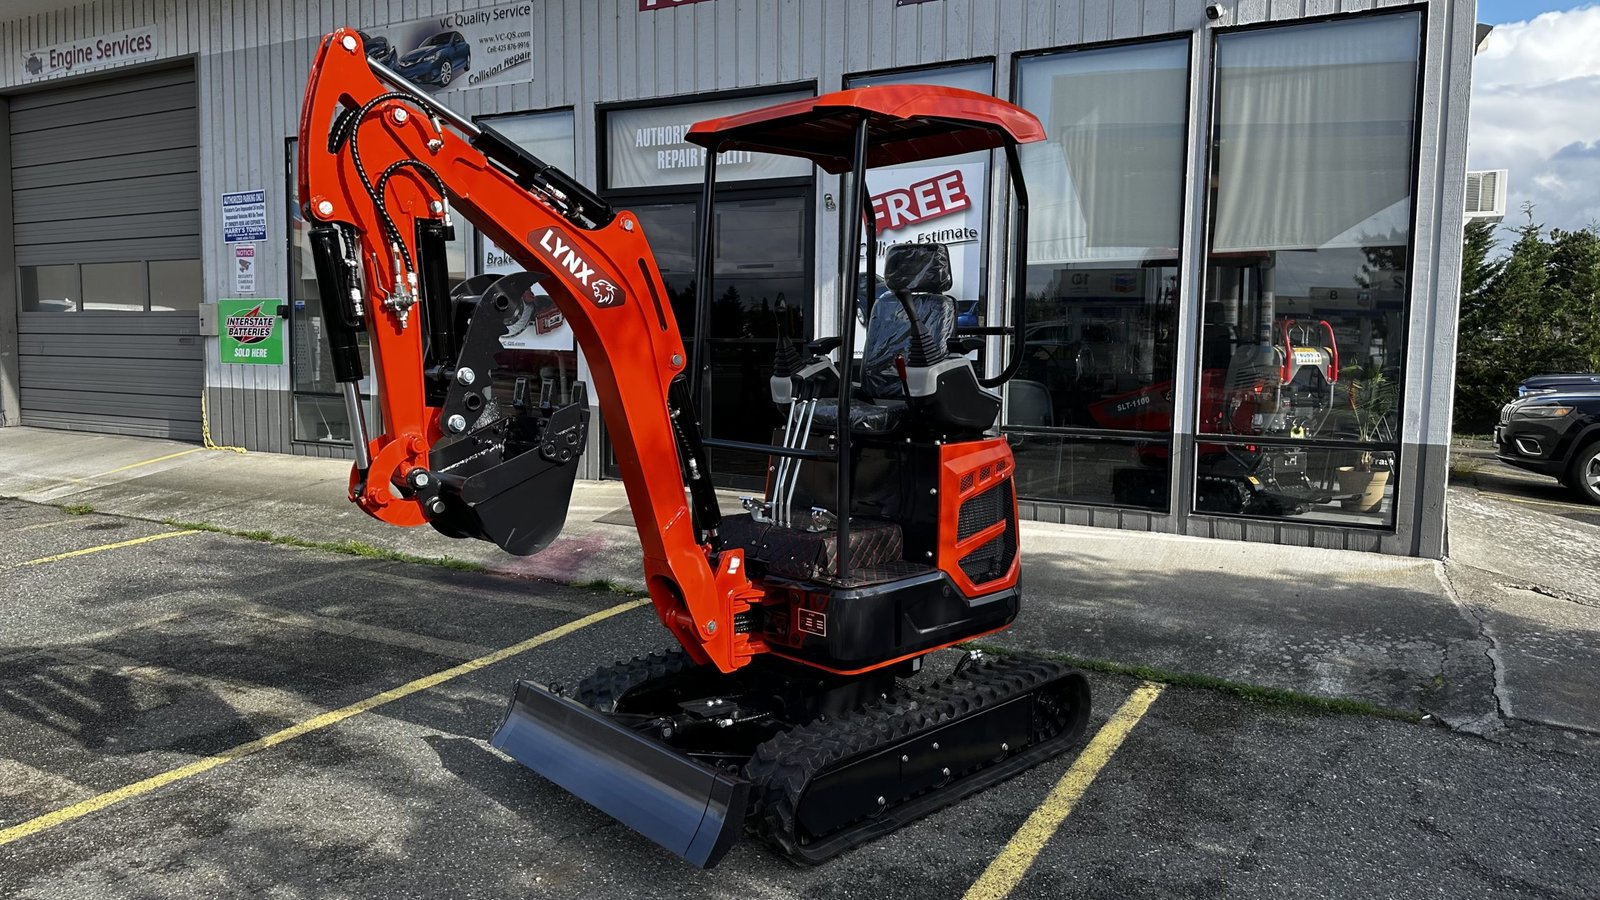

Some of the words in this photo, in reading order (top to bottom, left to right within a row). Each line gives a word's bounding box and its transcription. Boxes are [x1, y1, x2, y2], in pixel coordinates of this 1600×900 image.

[440, 16, 453, 29] VC
[455, 11, 491, 27] Quality
[493, 4, 531, 20] Service
[479, 31, 531, 44] www.VC-QS.com
[49, 45, 93, 70] Engine
[96, 34, 152, 60] Services
[468, 63, 502, 85] Collision
[504, 51, 531, 68] Repair
[657, 147, 698, 169] REPAIR
[246, 225, 266, 233] TOWING
[918, 227, 978, 244] Estimate
[540, 228, 595, 286] LYNX
[227, 317, 273, 326] INTERSTATE
[229, 328, 270, 336] BATTERIES
[234, 348, 250, 358] SOLD
[251, 348, 268, 358] HERE
[1117, 396, 1150, 411] SLT-1100
